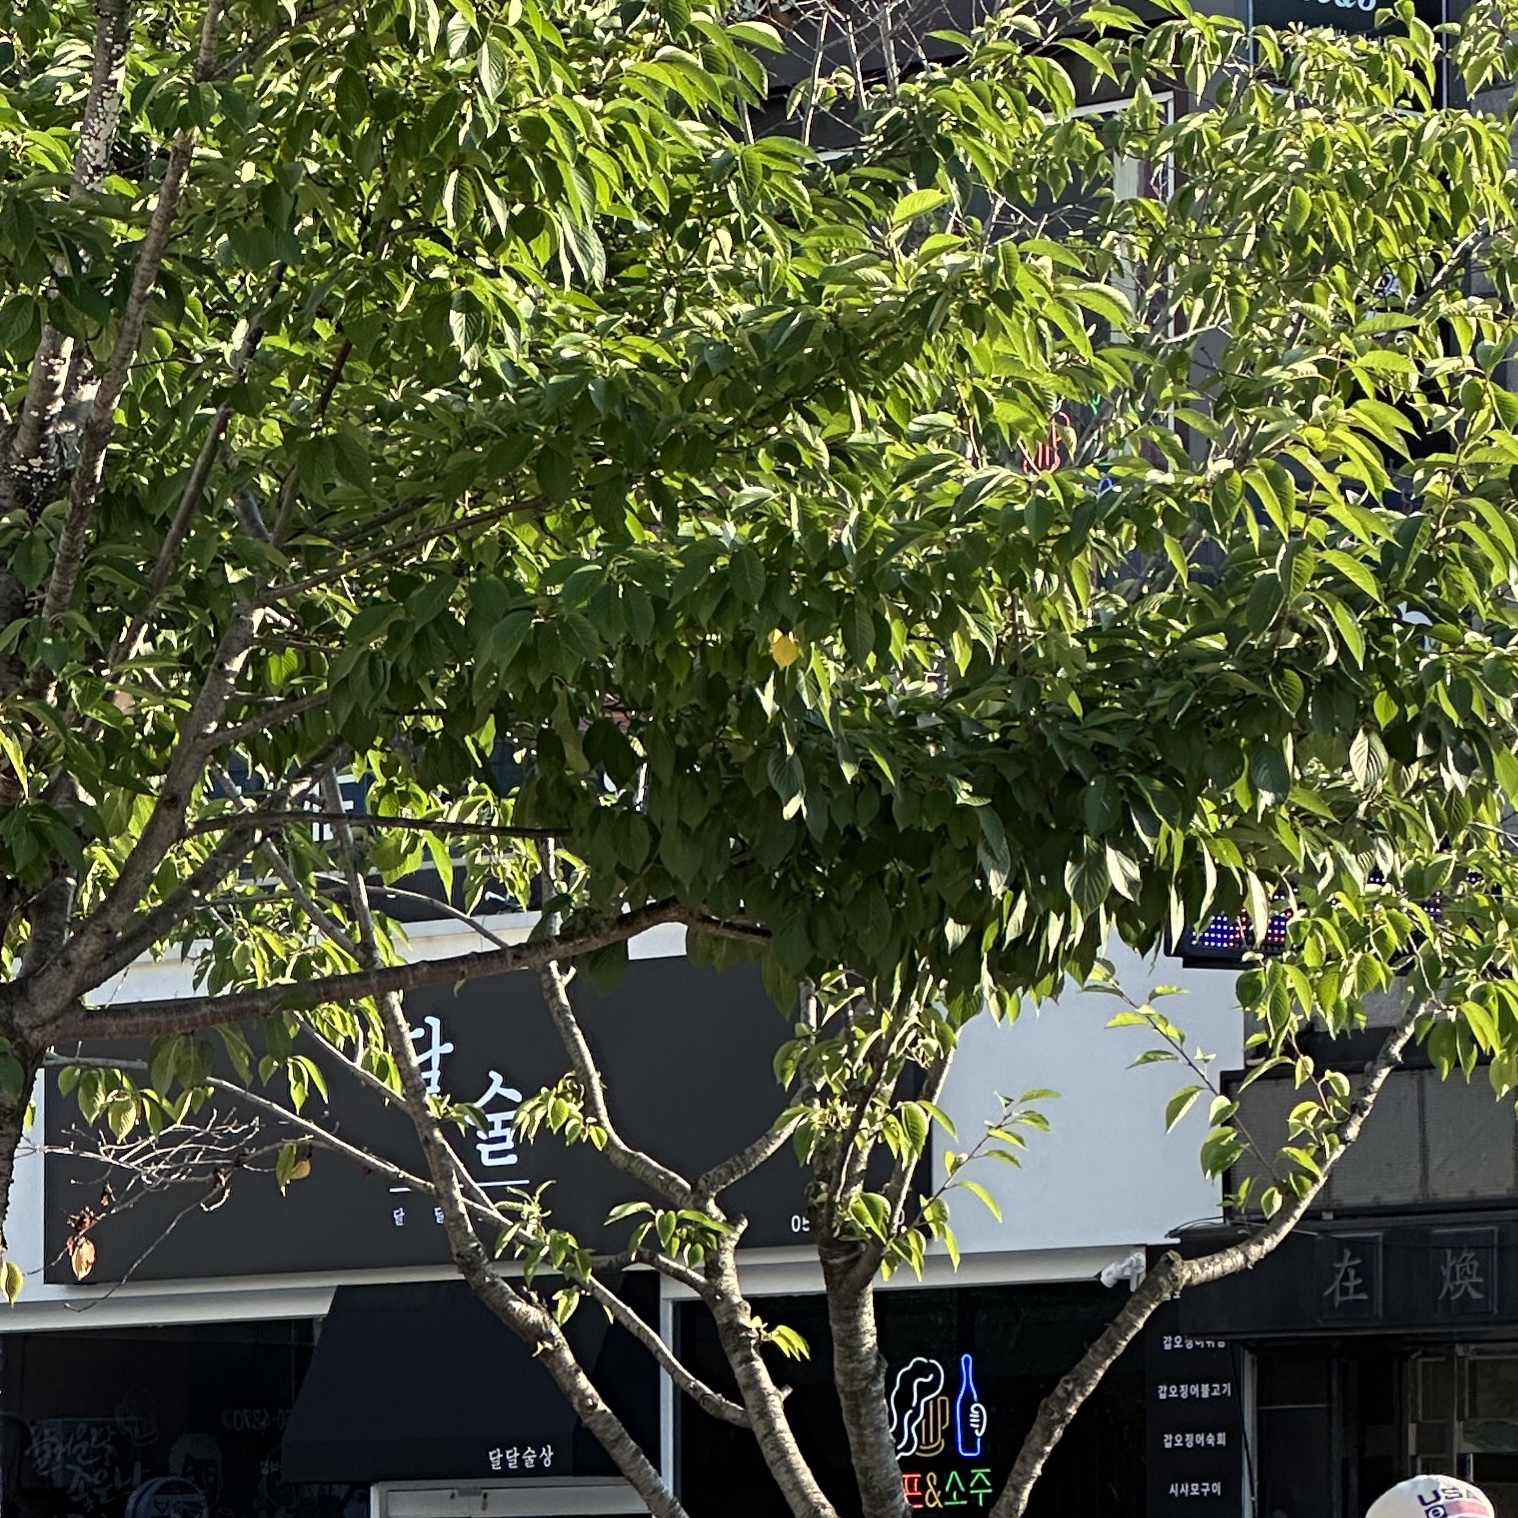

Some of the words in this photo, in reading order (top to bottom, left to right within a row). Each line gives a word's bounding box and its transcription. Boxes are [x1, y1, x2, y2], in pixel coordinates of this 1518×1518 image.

[1158, 1382, 1232, 1400] 갑오징어불고기
[1163, 1432, 1227, 1449] 갑오징어숙회
[488, 1444, 554, 1471] 달달술상
[1417, 1486, 1483, 1507] USA
